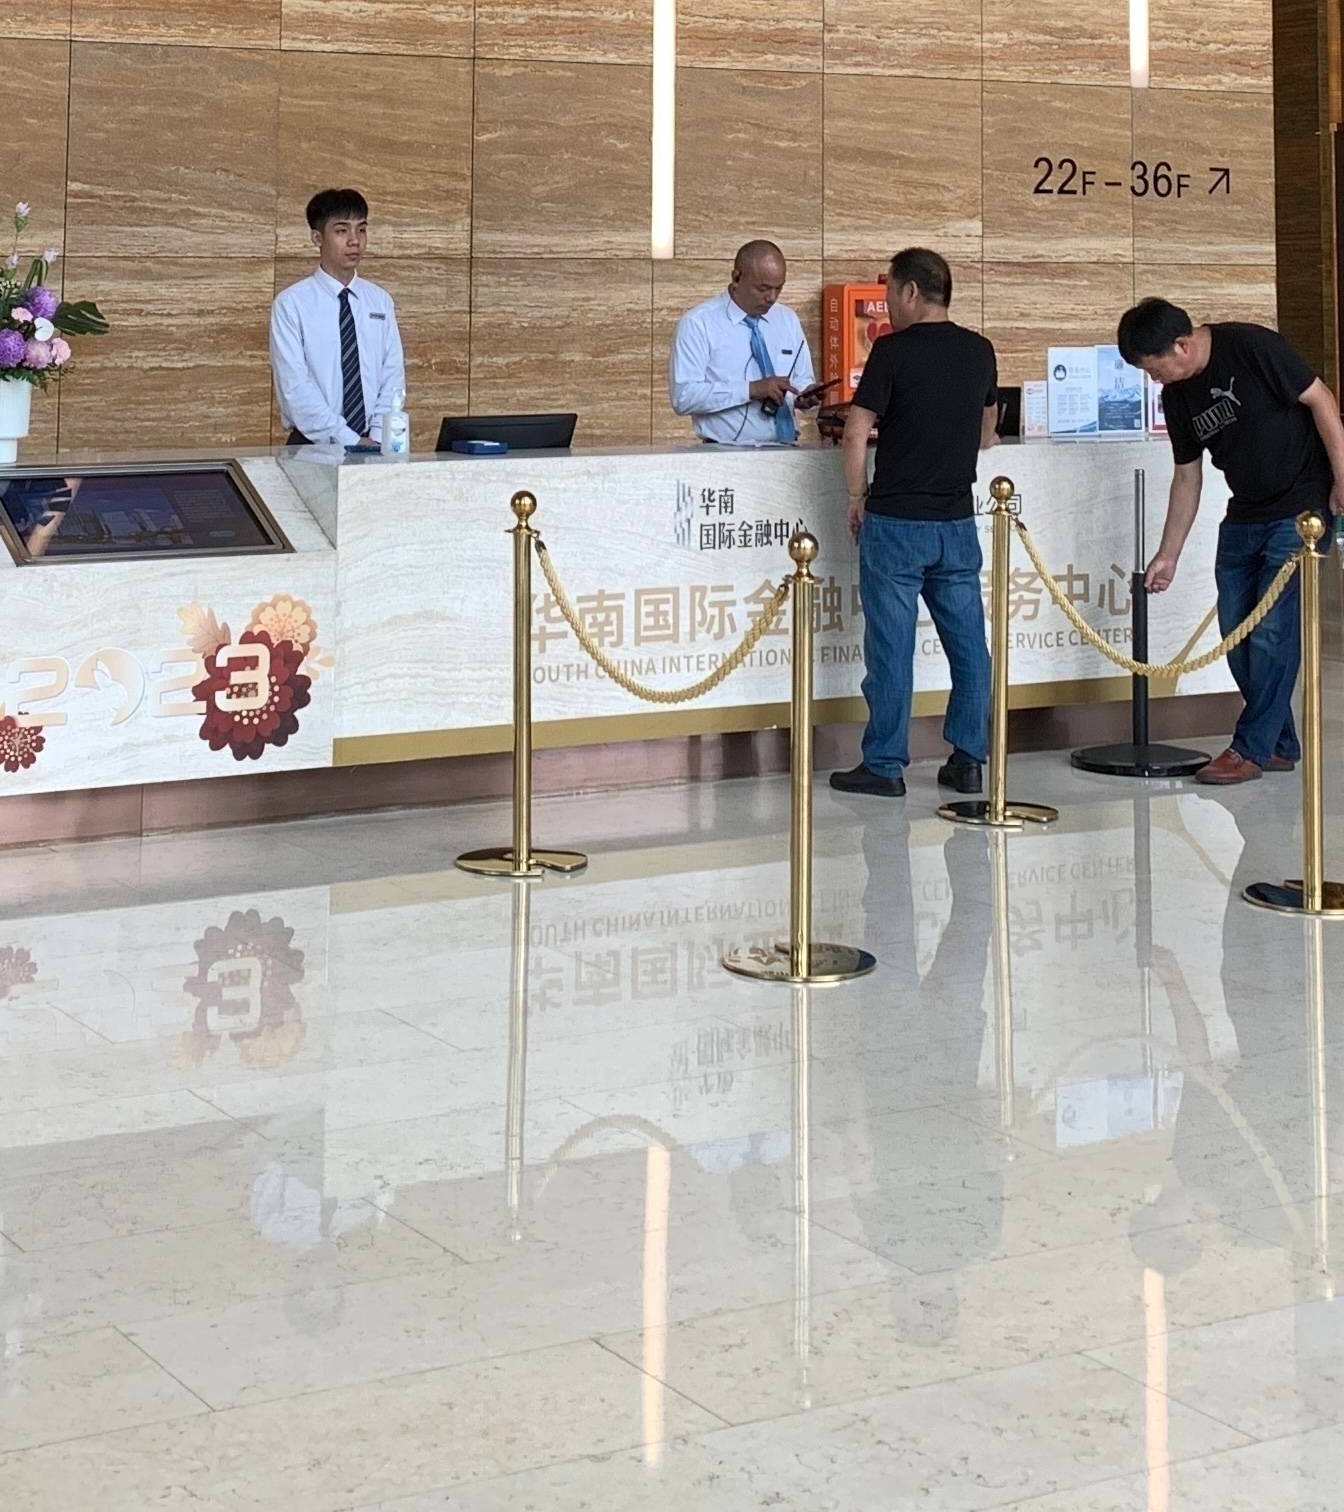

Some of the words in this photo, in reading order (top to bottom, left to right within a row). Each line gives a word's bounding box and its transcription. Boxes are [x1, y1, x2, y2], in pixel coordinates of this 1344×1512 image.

[699, 487, 736, 516] 华南
[1007, 630, 1064, 650] ERVICE
[532, 663, 589, 684] OUTH
